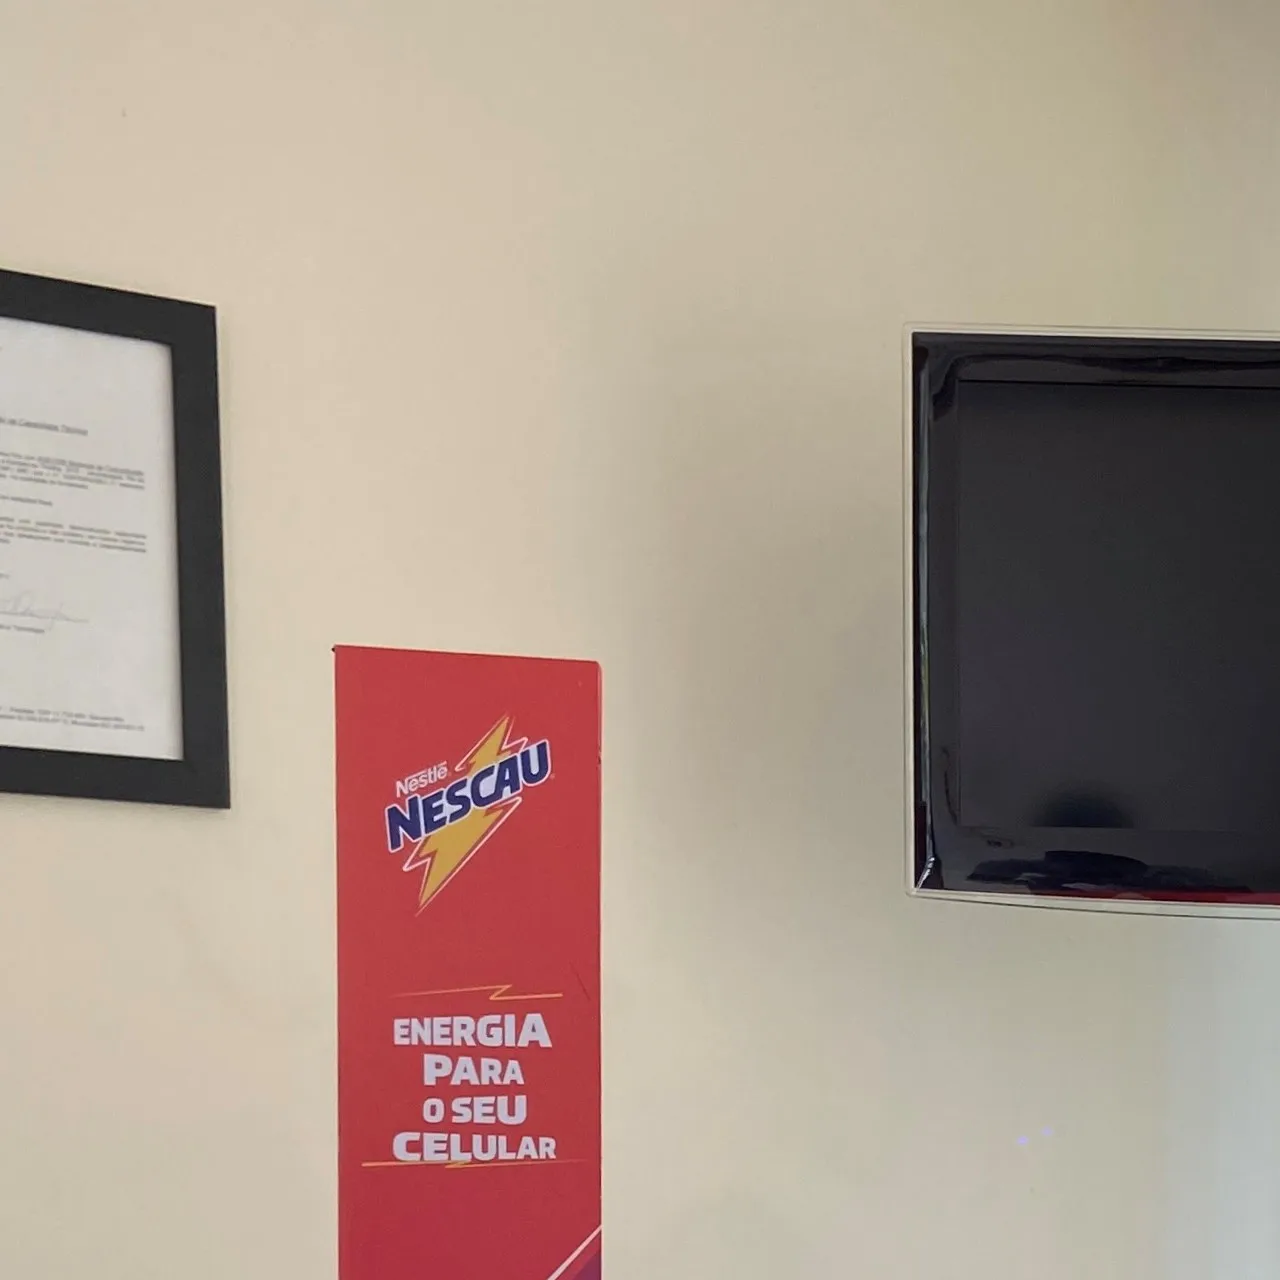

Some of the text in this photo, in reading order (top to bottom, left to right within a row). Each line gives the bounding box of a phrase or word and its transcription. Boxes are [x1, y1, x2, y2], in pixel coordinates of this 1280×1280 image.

[385, 739, 551, 853] NESCAU
[394, 1013, 552, 1048] ENERGIA
[423, 1053, 525, 1086] PARA
[423, 1095, 527, 1125] O SEU
[392, 1132, 557, 1162] CELULAR
